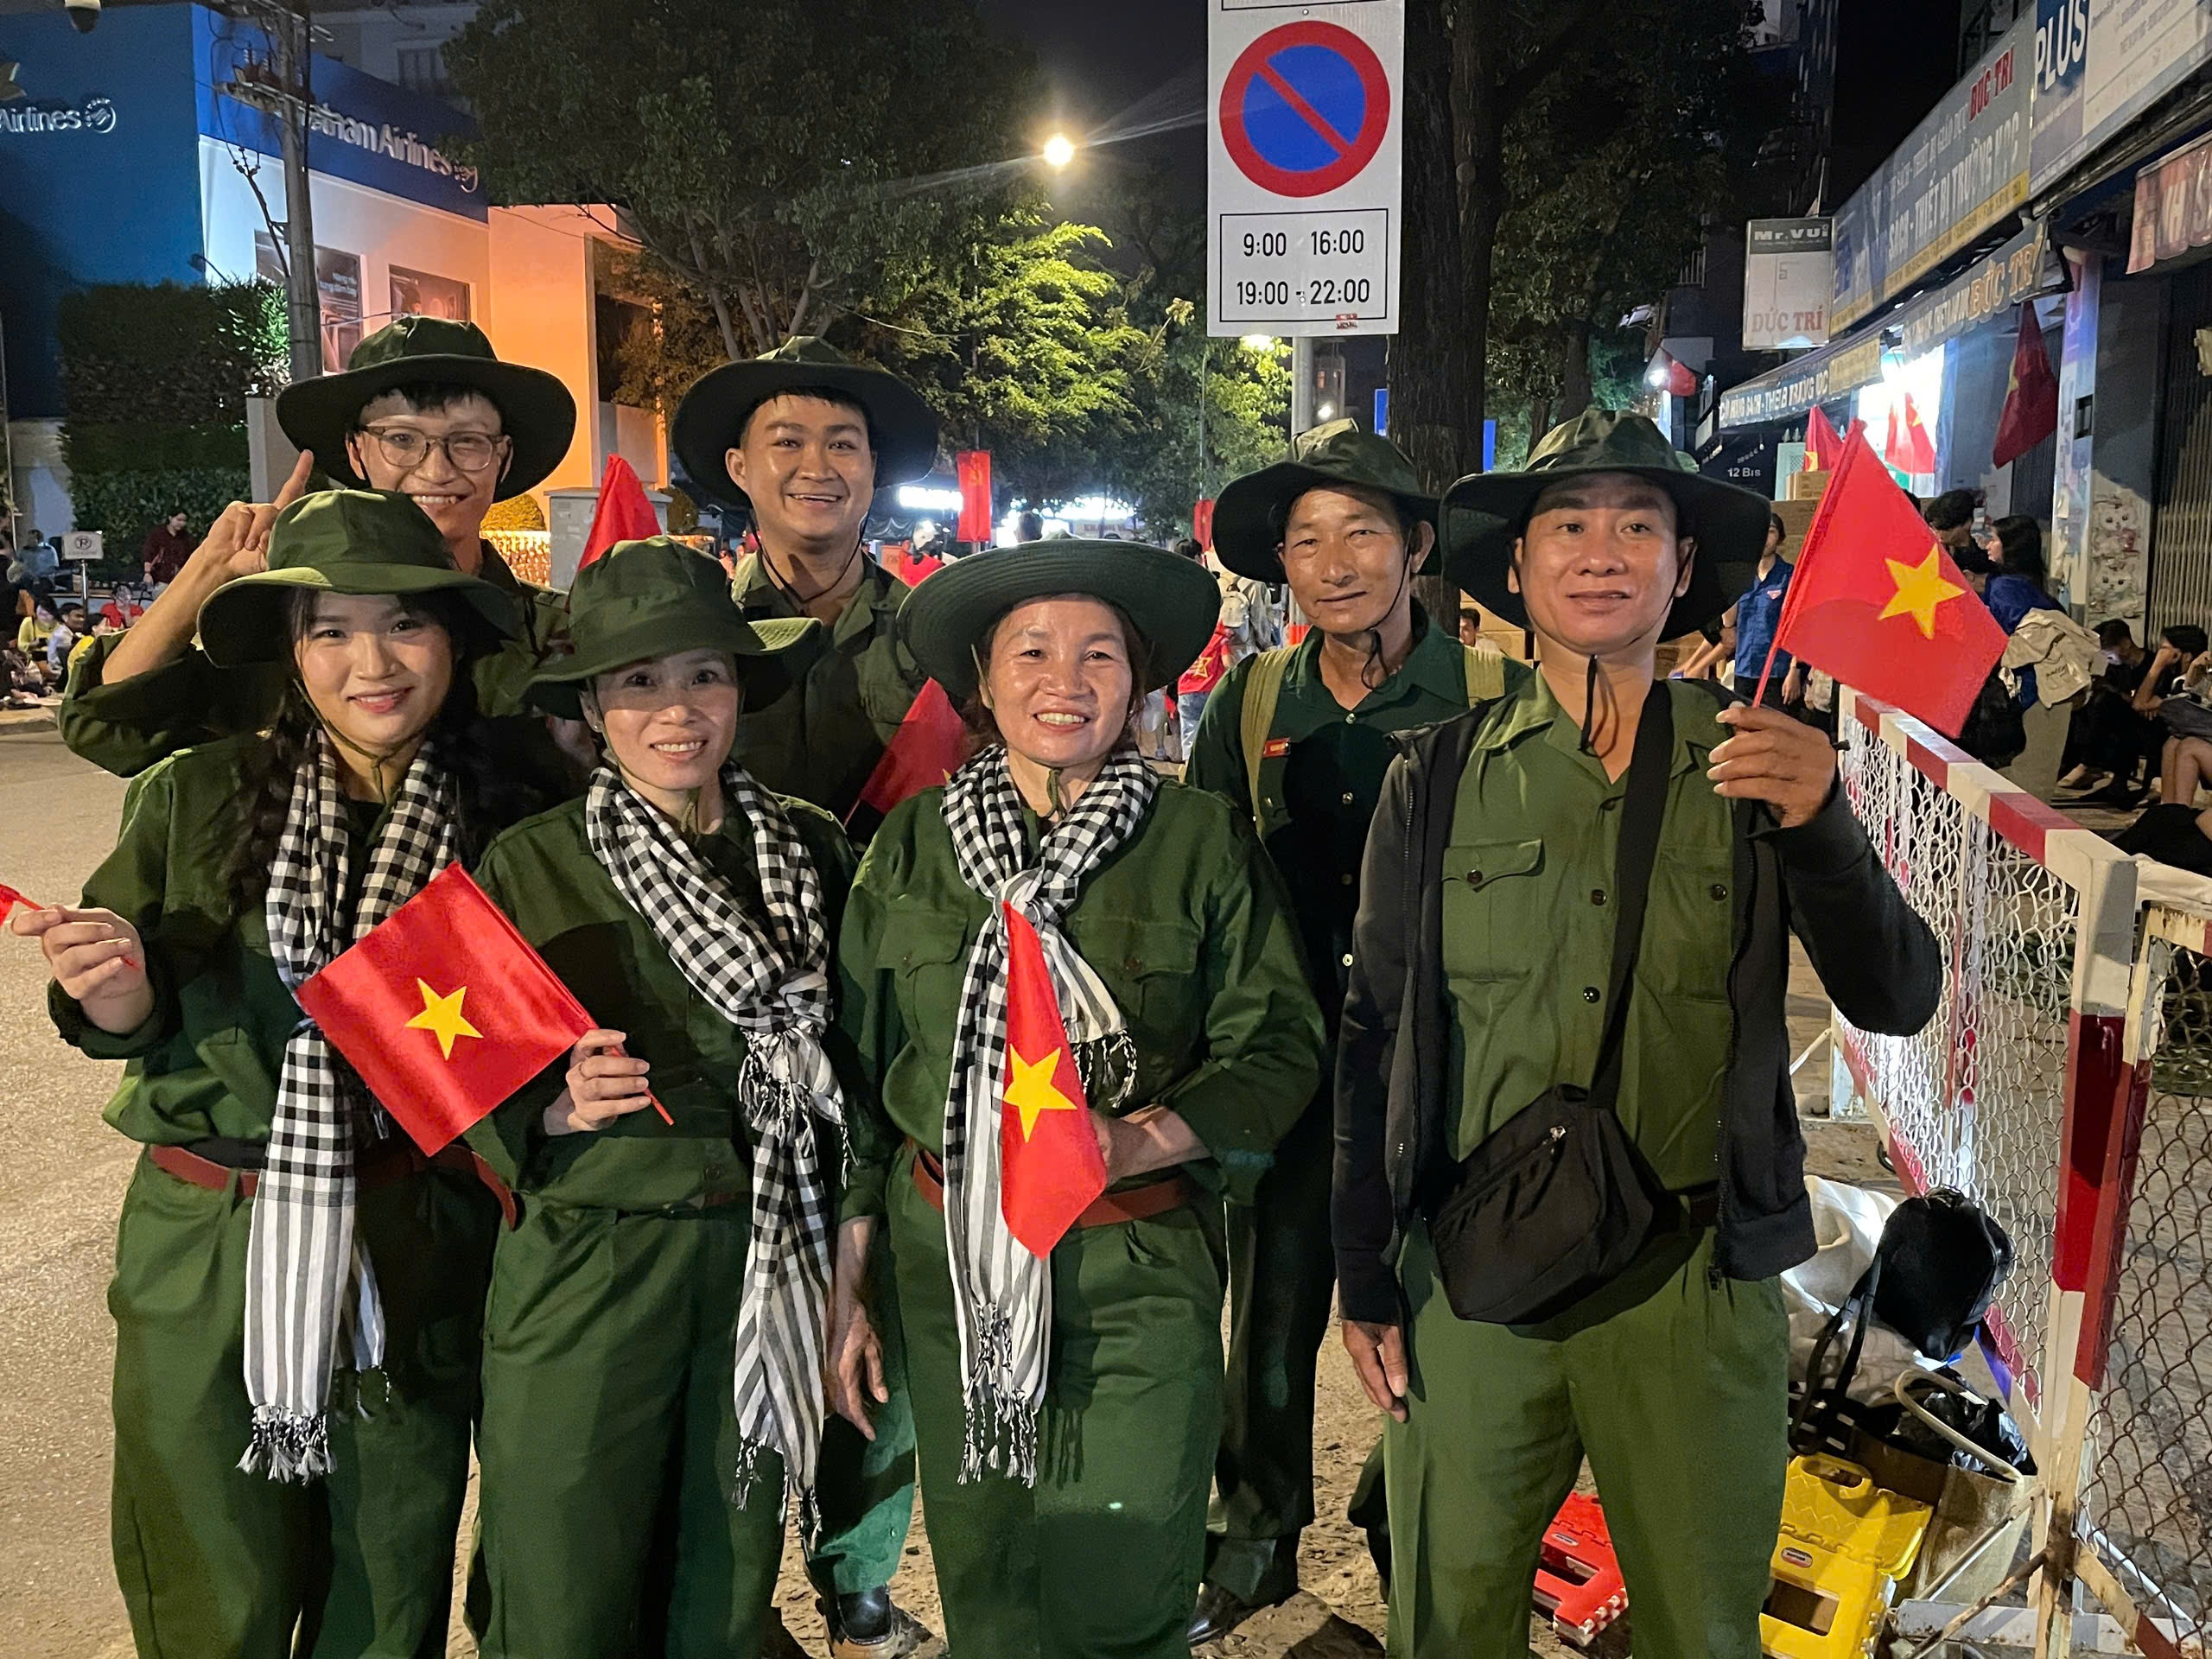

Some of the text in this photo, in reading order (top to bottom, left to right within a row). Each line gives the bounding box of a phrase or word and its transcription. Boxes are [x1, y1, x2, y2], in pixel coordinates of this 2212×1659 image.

[2033, 0, 2087, 103] PLUS
[0, 107, 81, 132] Airlines
[378, 124, 453, 175] Airlines
[1243, 229, 1364, 257] 9:00 16:00
[1236, 280, 1288, 305] 19:00
[1310, 278, 1370, 304] 22:00
[1793, 304, 1823, 331] TRÍ
[1728, 467, 1739, 477] 12
